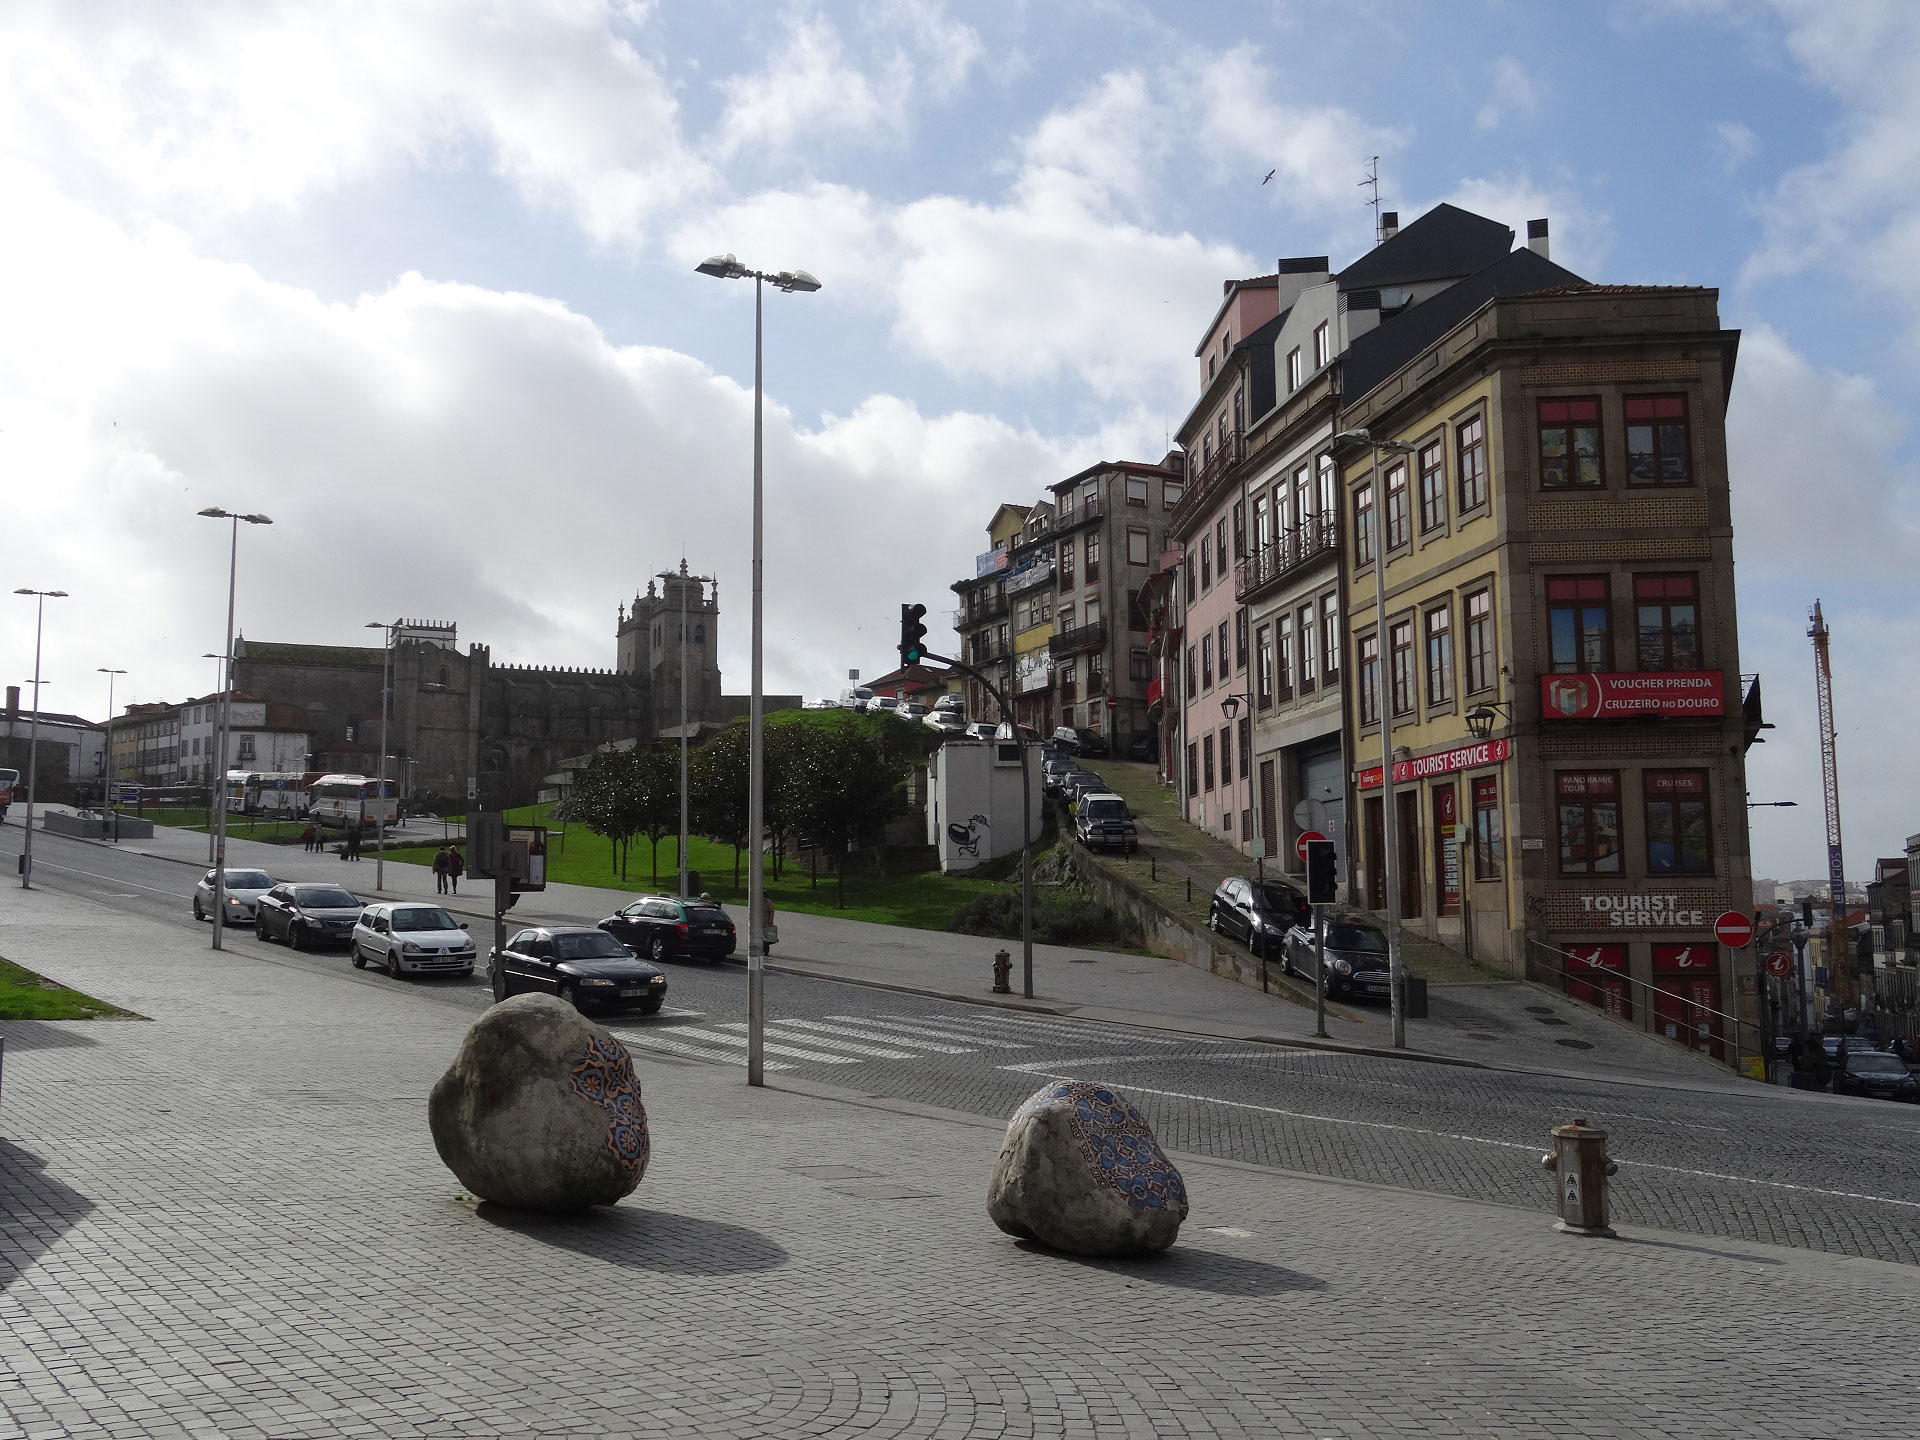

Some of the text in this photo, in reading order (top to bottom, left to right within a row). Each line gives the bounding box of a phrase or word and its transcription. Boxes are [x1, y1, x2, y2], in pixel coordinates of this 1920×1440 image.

[1610, 678, 1712, 689] VOUCHER PRENDA
[1605, 699, 1660, 709] CRUZEIRO
[1677, 698, 1719, 708] DOURO
[1412, 754, 1449, 776] TOURIST
[1450, 745, 1488, 769] SERVICE
[1562, 776, 1614, 784] PANORAMIC
[1656, 779, 1693, 787] CRUISES
[1831, 853, 1844, 893] LUCIOS
[1580, 895, 1678, 912] TOURIST
[1610, 911, 1704, 926] SERVICE
[1605, 987, 1613, 1014] OURIST
